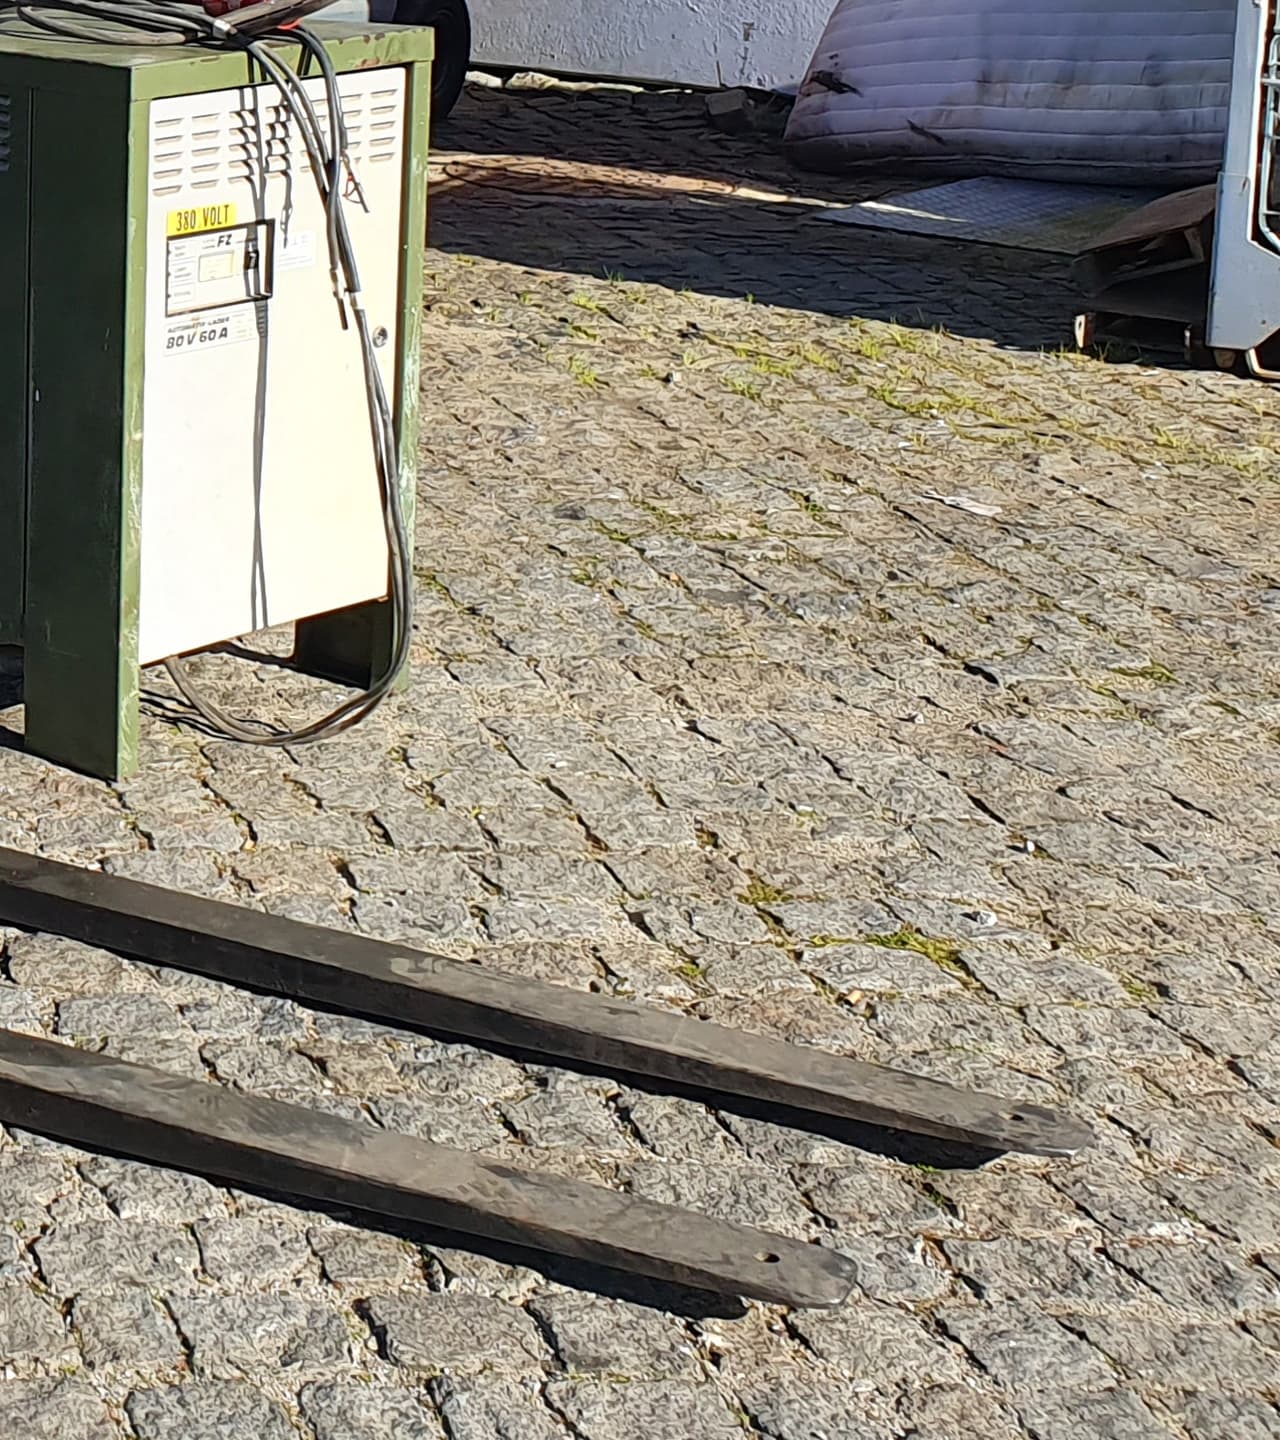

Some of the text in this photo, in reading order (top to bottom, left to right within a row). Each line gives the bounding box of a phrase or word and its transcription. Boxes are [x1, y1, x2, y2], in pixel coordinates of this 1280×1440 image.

[176, 204, 230, 231] 380 VOLT
[166, 327, 228, 349] 80 V 60 A
